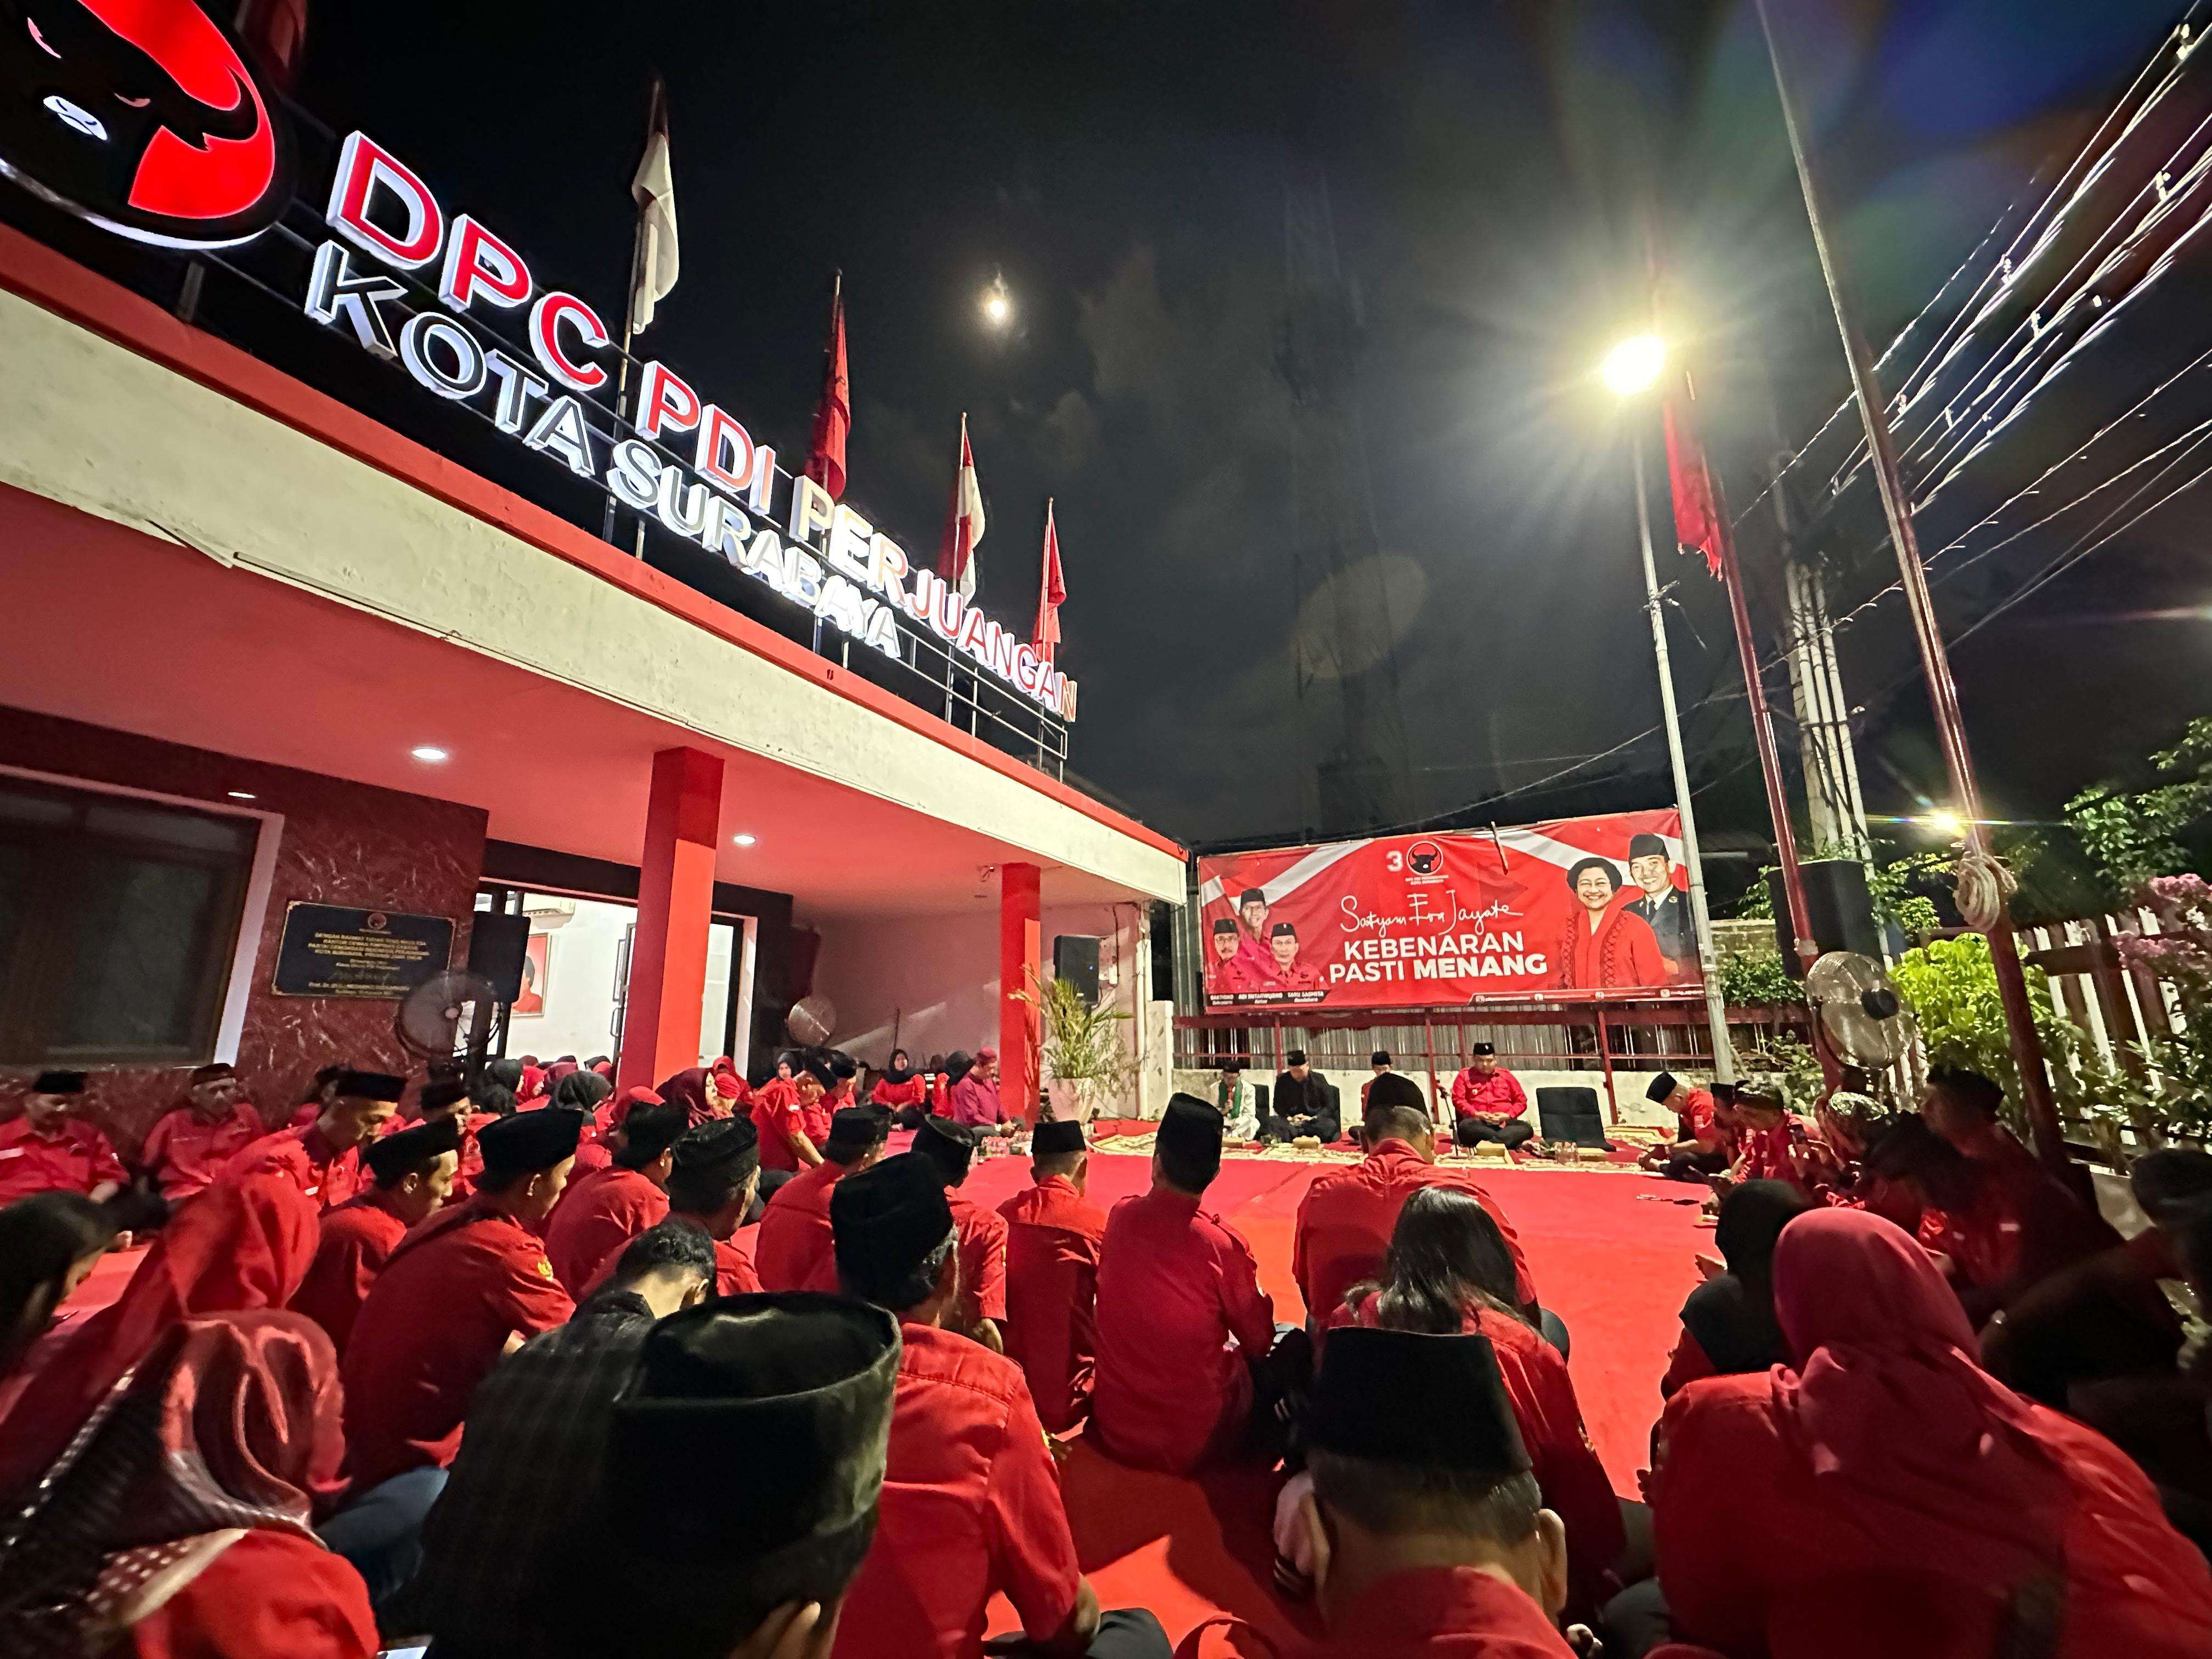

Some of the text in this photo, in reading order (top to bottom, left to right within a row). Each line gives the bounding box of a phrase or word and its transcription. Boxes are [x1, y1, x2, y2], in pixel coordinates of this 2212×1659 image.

[326, 130, 1077, 723] DPC PDI PERJUANGAN
[304, 239, 901, 659] KOTA SURABAYA
[1386, 850, 1404, 872] 3
[1340, 895, 1407, 938] Satyam
[1344, 930, 1524, 961] KEBENARAN
[1329, 953, 1548, 983] PASTI MENANG
